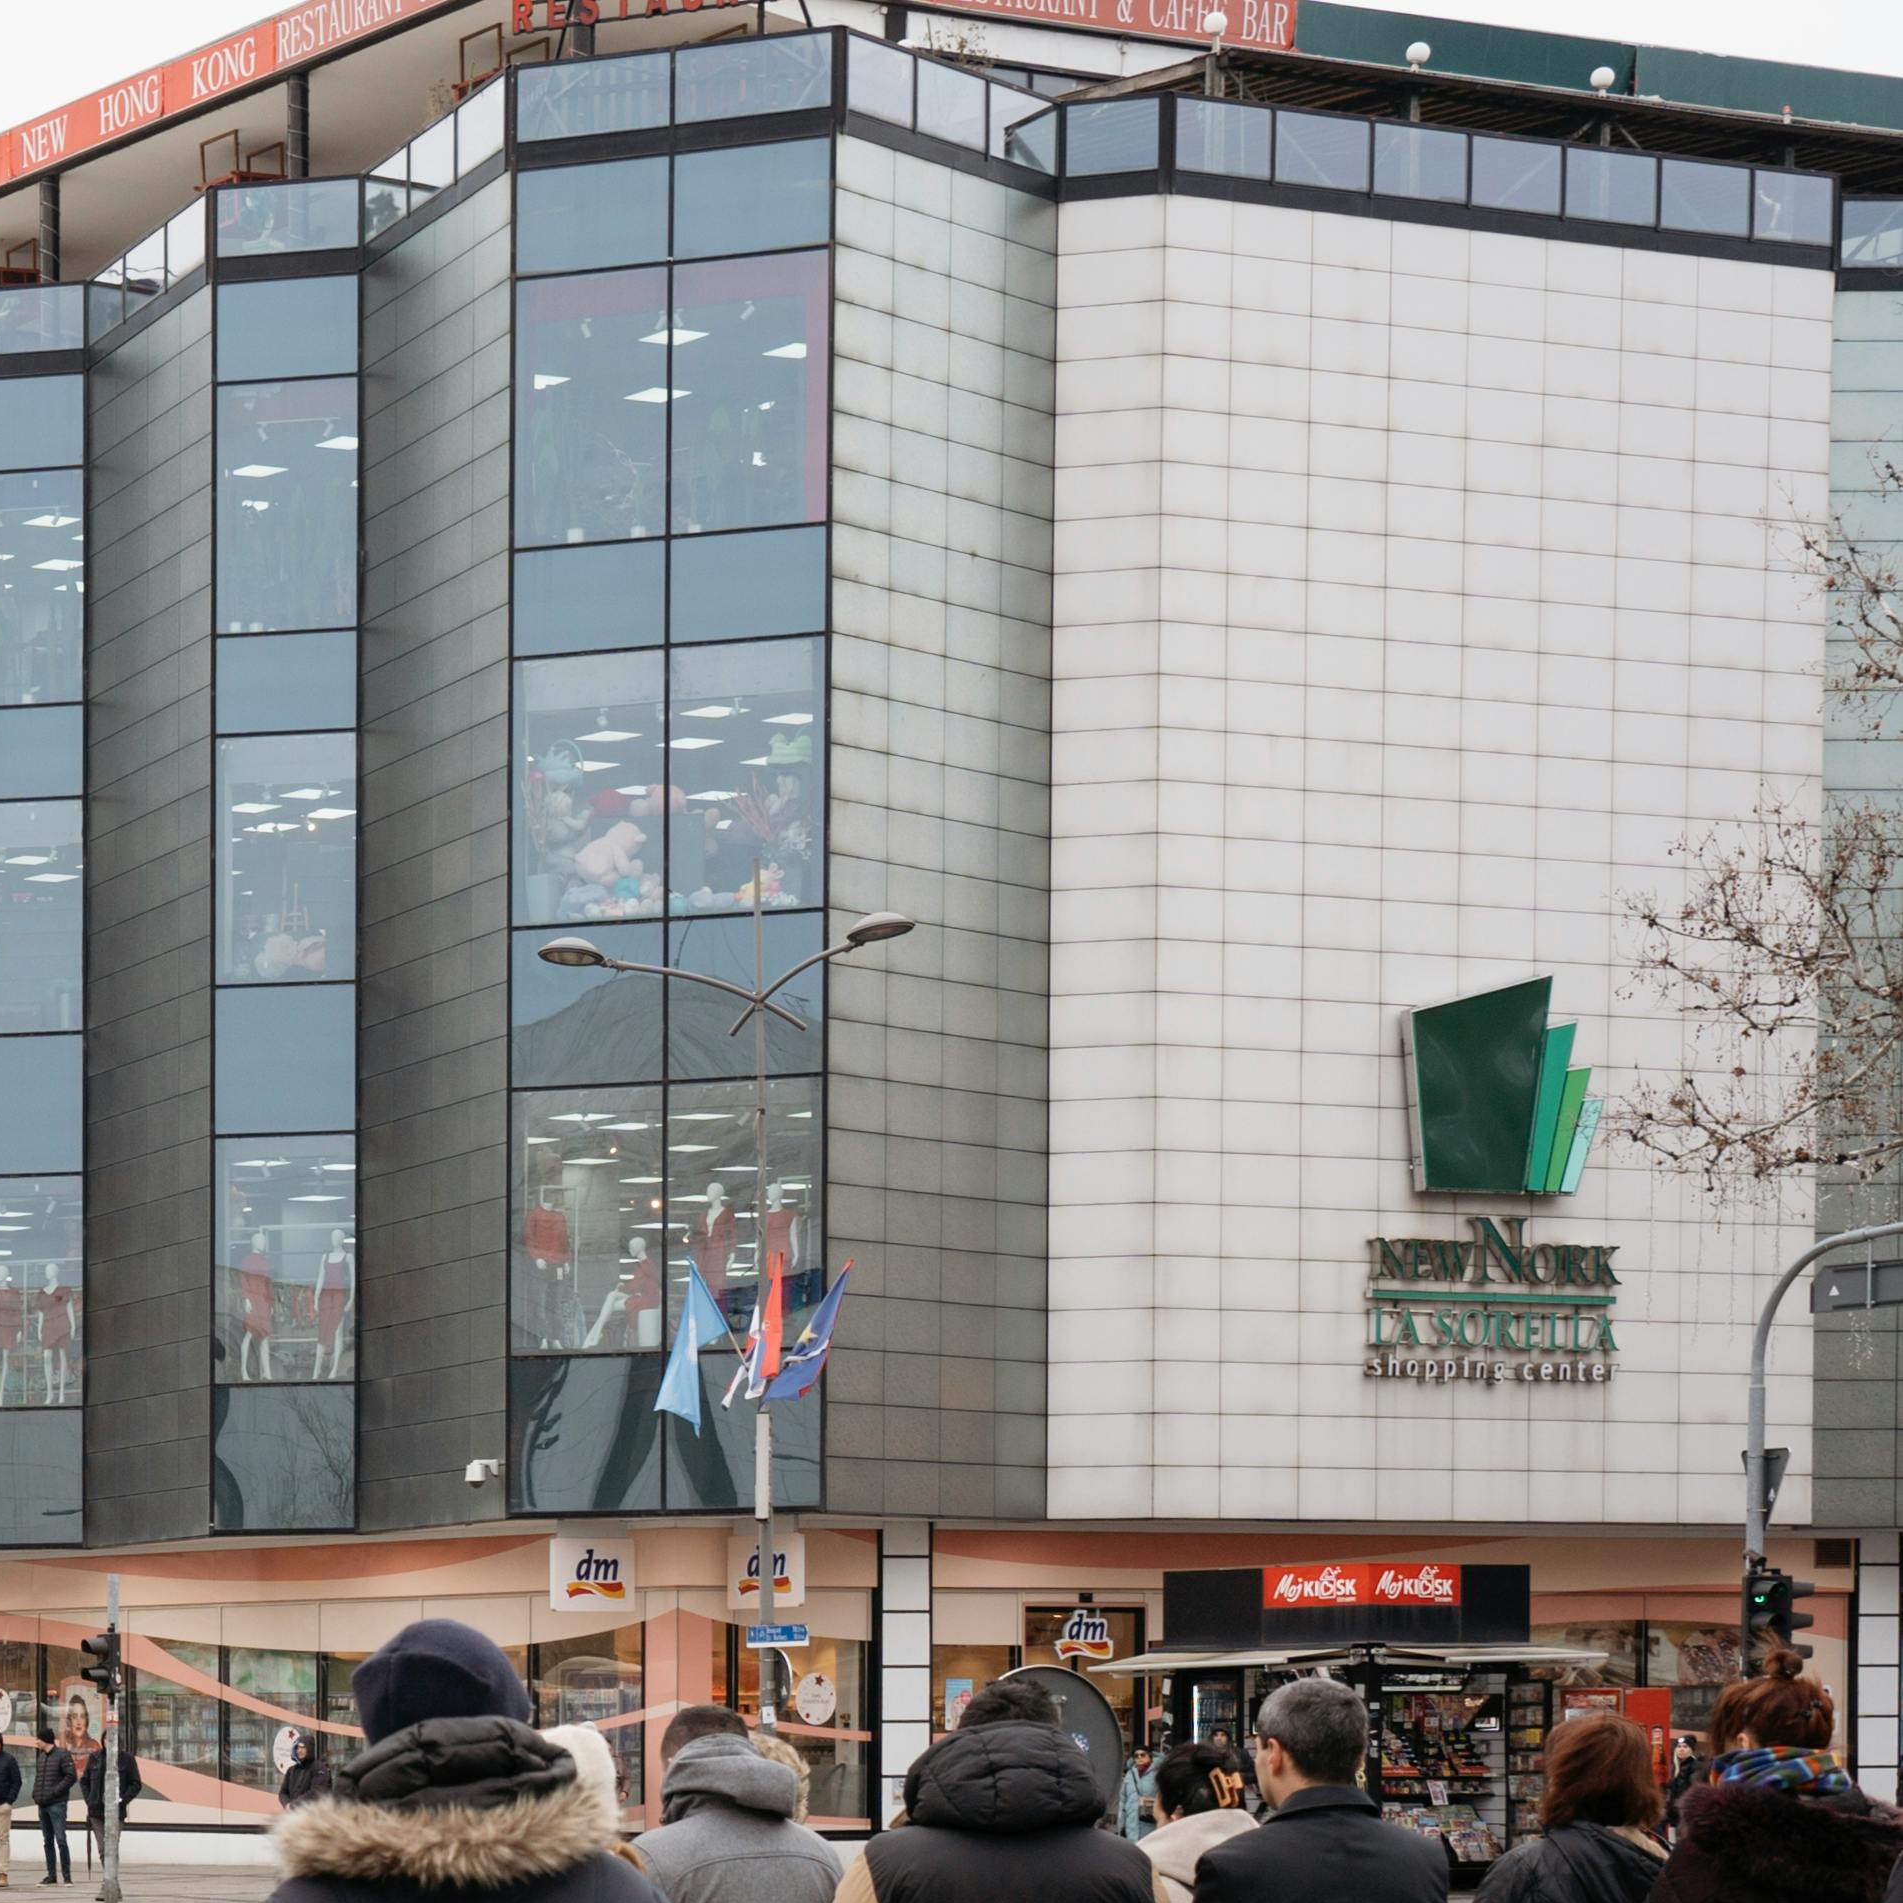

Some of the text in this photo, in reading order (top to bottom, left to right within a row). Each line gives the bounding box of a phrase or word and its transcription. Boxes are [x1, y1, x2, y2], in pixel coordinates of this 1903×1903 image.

[1240, 0, 1289, 46] BAR
[21, 114, 69, 168] NEW
[98, 74, 160, 136] HONG
[191, 36, 257, 99] KONG
[1370, 1307, 1620, 1351] LA SORELLA
[1370, 1354, 1621, 1384] shopping center
[576, 1549, 619, 1580] dm
[1274, 1574, 1304, 1602] Moj
[1375, 1570, 1404, 1600] Moj
[1069, 1613, 1105, 1641] dm
